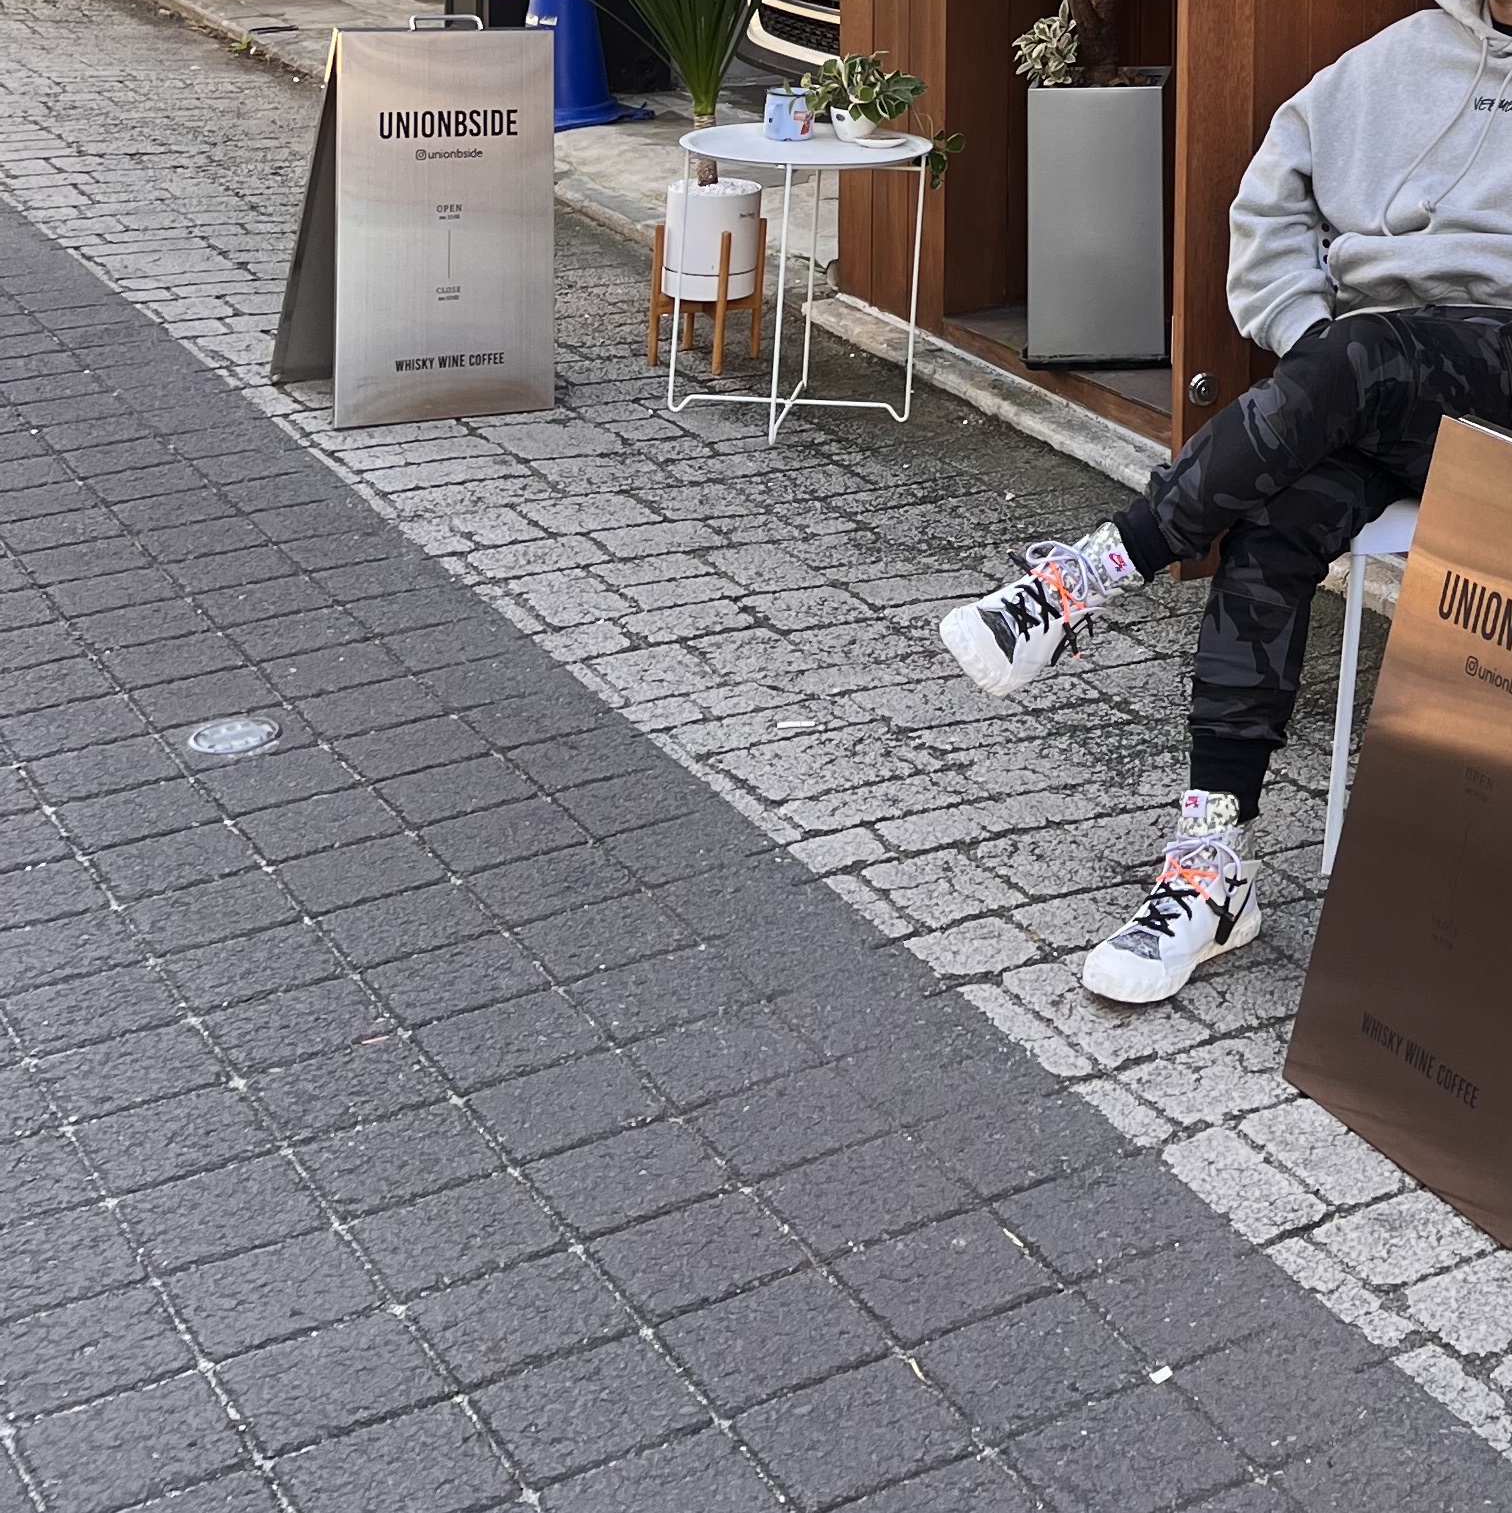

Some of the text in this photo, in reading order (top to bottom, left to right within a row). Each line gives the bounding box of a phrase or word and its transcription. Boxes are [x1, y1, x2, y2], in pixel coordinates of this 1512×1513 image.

[379, 109, 519, 140] UNIONBSIDE
[436, 204, 462, 213] OPEN
[395, 351, 505, 372] WHISKY WINE COFFEE
[1361, 1011, 1480, 1109] WHISKY WINE COFFEE
